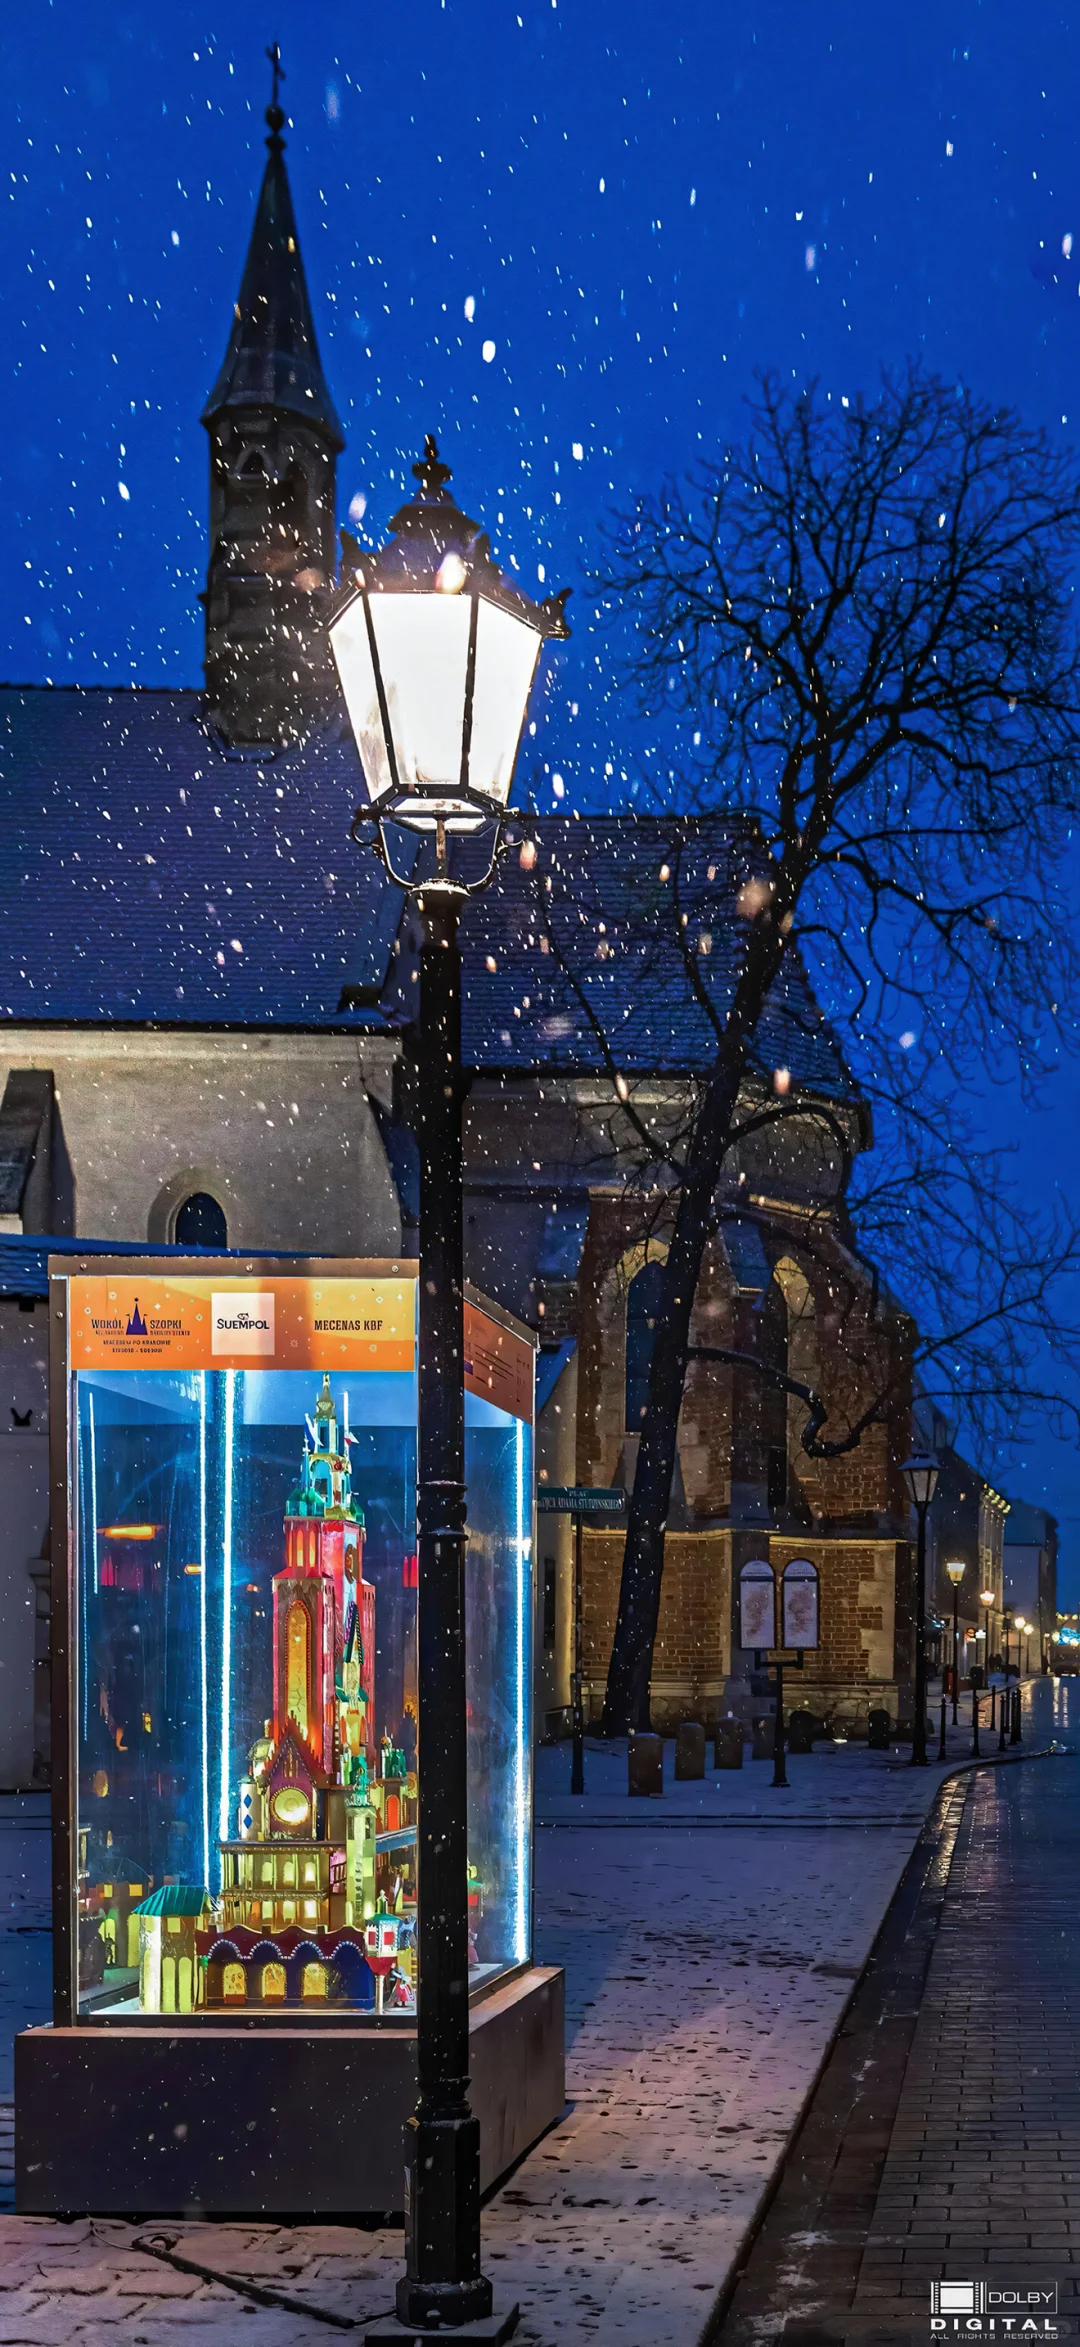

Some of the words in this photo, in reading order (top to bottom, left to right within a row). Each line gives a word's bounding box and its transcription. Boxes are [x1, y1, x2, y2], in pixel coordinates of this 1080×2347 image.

[150, 1319, 182, 1329] SZOPKI
[216, 1318, 270, 1330] SUEMPOL
[314, 1319, 361, 1331] MECENAS
[364, 1319, 383, 1331] KBF
